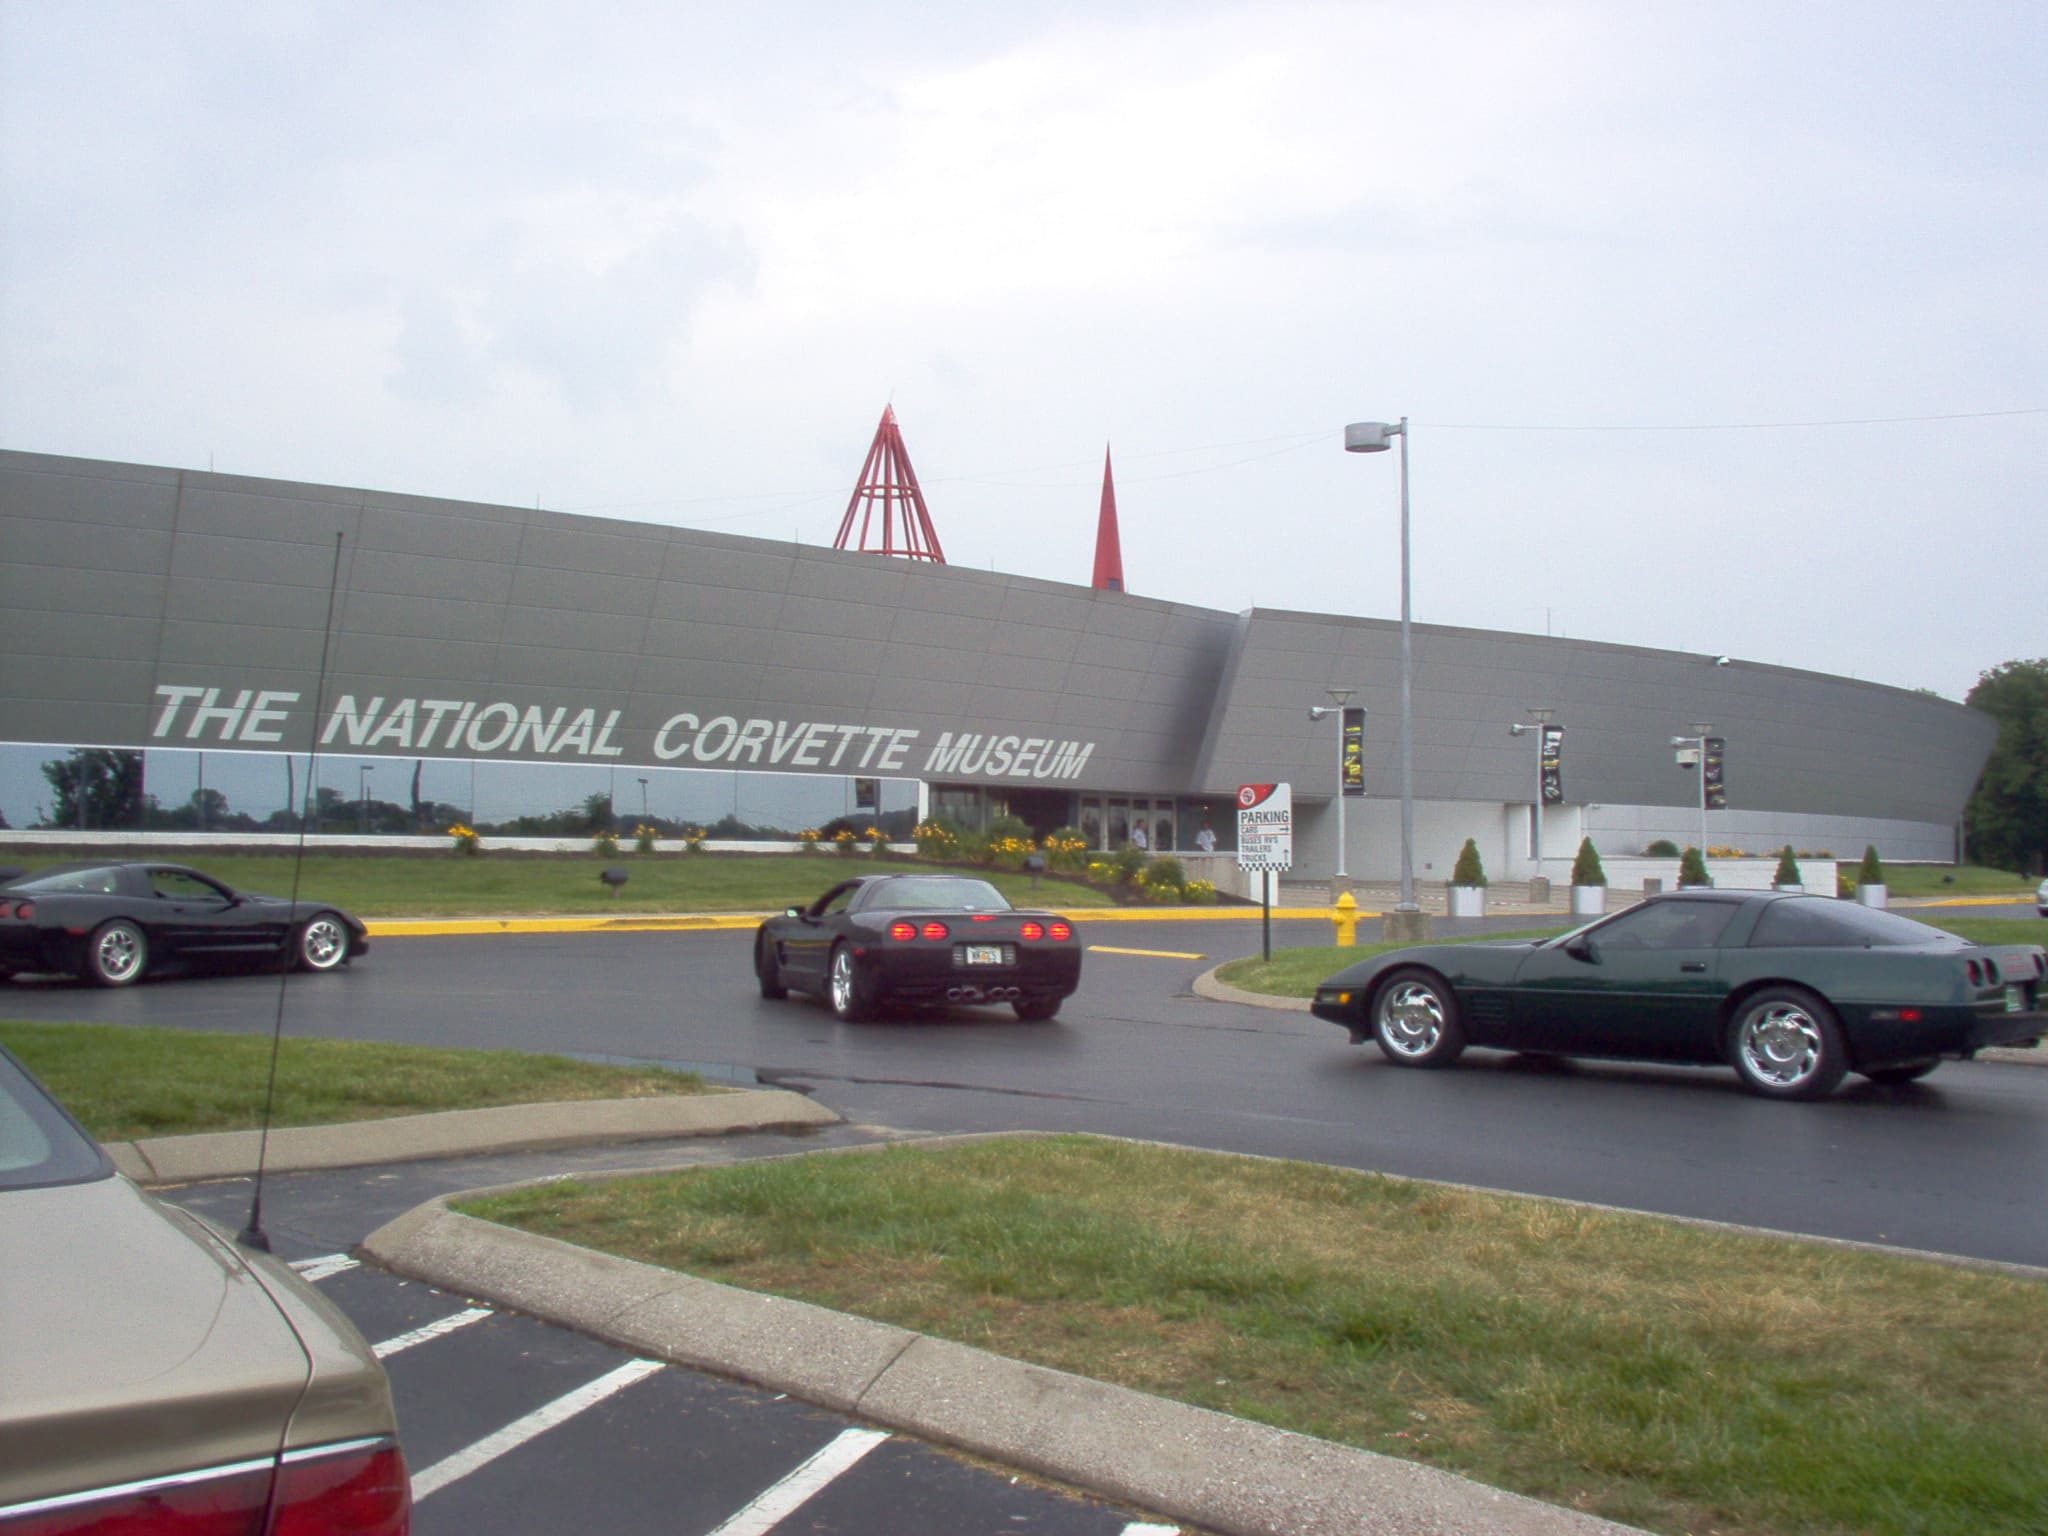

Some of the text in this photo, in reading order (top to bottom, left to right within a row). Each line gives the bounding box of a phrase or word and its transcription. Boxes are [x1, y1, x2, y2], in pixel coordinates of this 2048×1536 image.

[152, 684, 1095, 779] THE NATIONAL CORVETTE MUSEUM
[1240, 810, 1289, 823] PARKING
[1240, 826, 1258, 834] CARS
